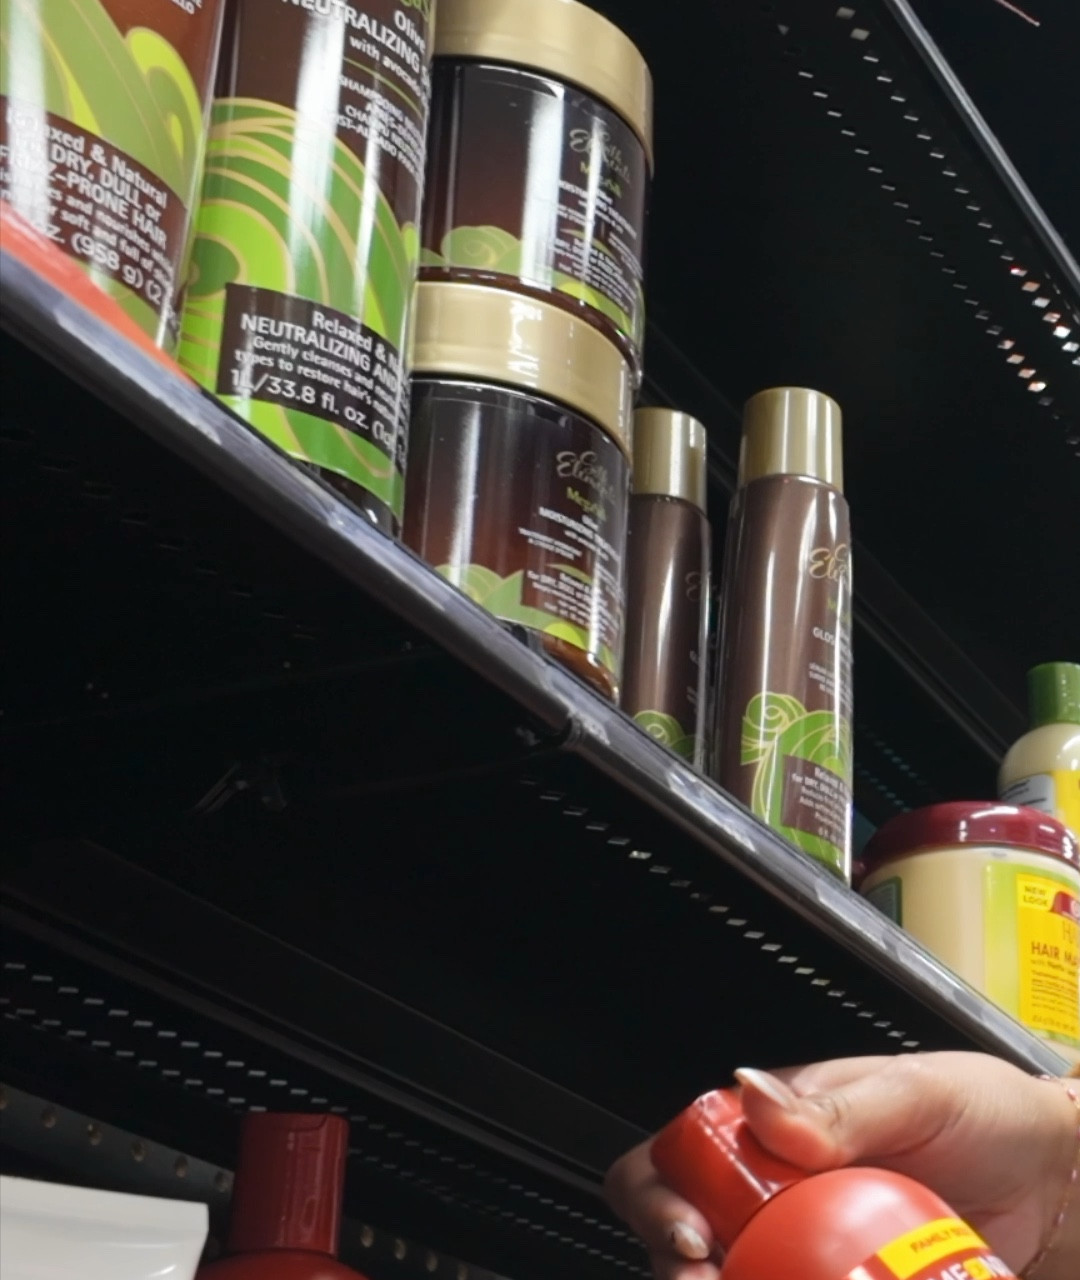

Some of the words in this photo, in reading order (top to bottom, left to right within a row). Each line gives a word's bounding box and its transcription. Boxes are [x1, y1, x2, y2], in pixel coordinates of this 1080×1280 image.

[349, 35, 380, 62] with
[393, 8, 426, 56] Olive
[99, 168, 144, 211] DULL
[111, 154, 168, 210] Natural
[131, 209, 168, 250] HAIR
[240, 312, 371, 373] NEUTRALIZING
[252, 335, 300, 361] Gently
[301, 349, 354, 380] cleanses
[311, 310, 373, 353] Relaxed
[373, 343, 387, 364] &
[233, 349, 275, 369] types
[277, 357, 295, 372] to
[296, 364, 342, 390] restore
[1031, 940, 1061, 962] HAIR
